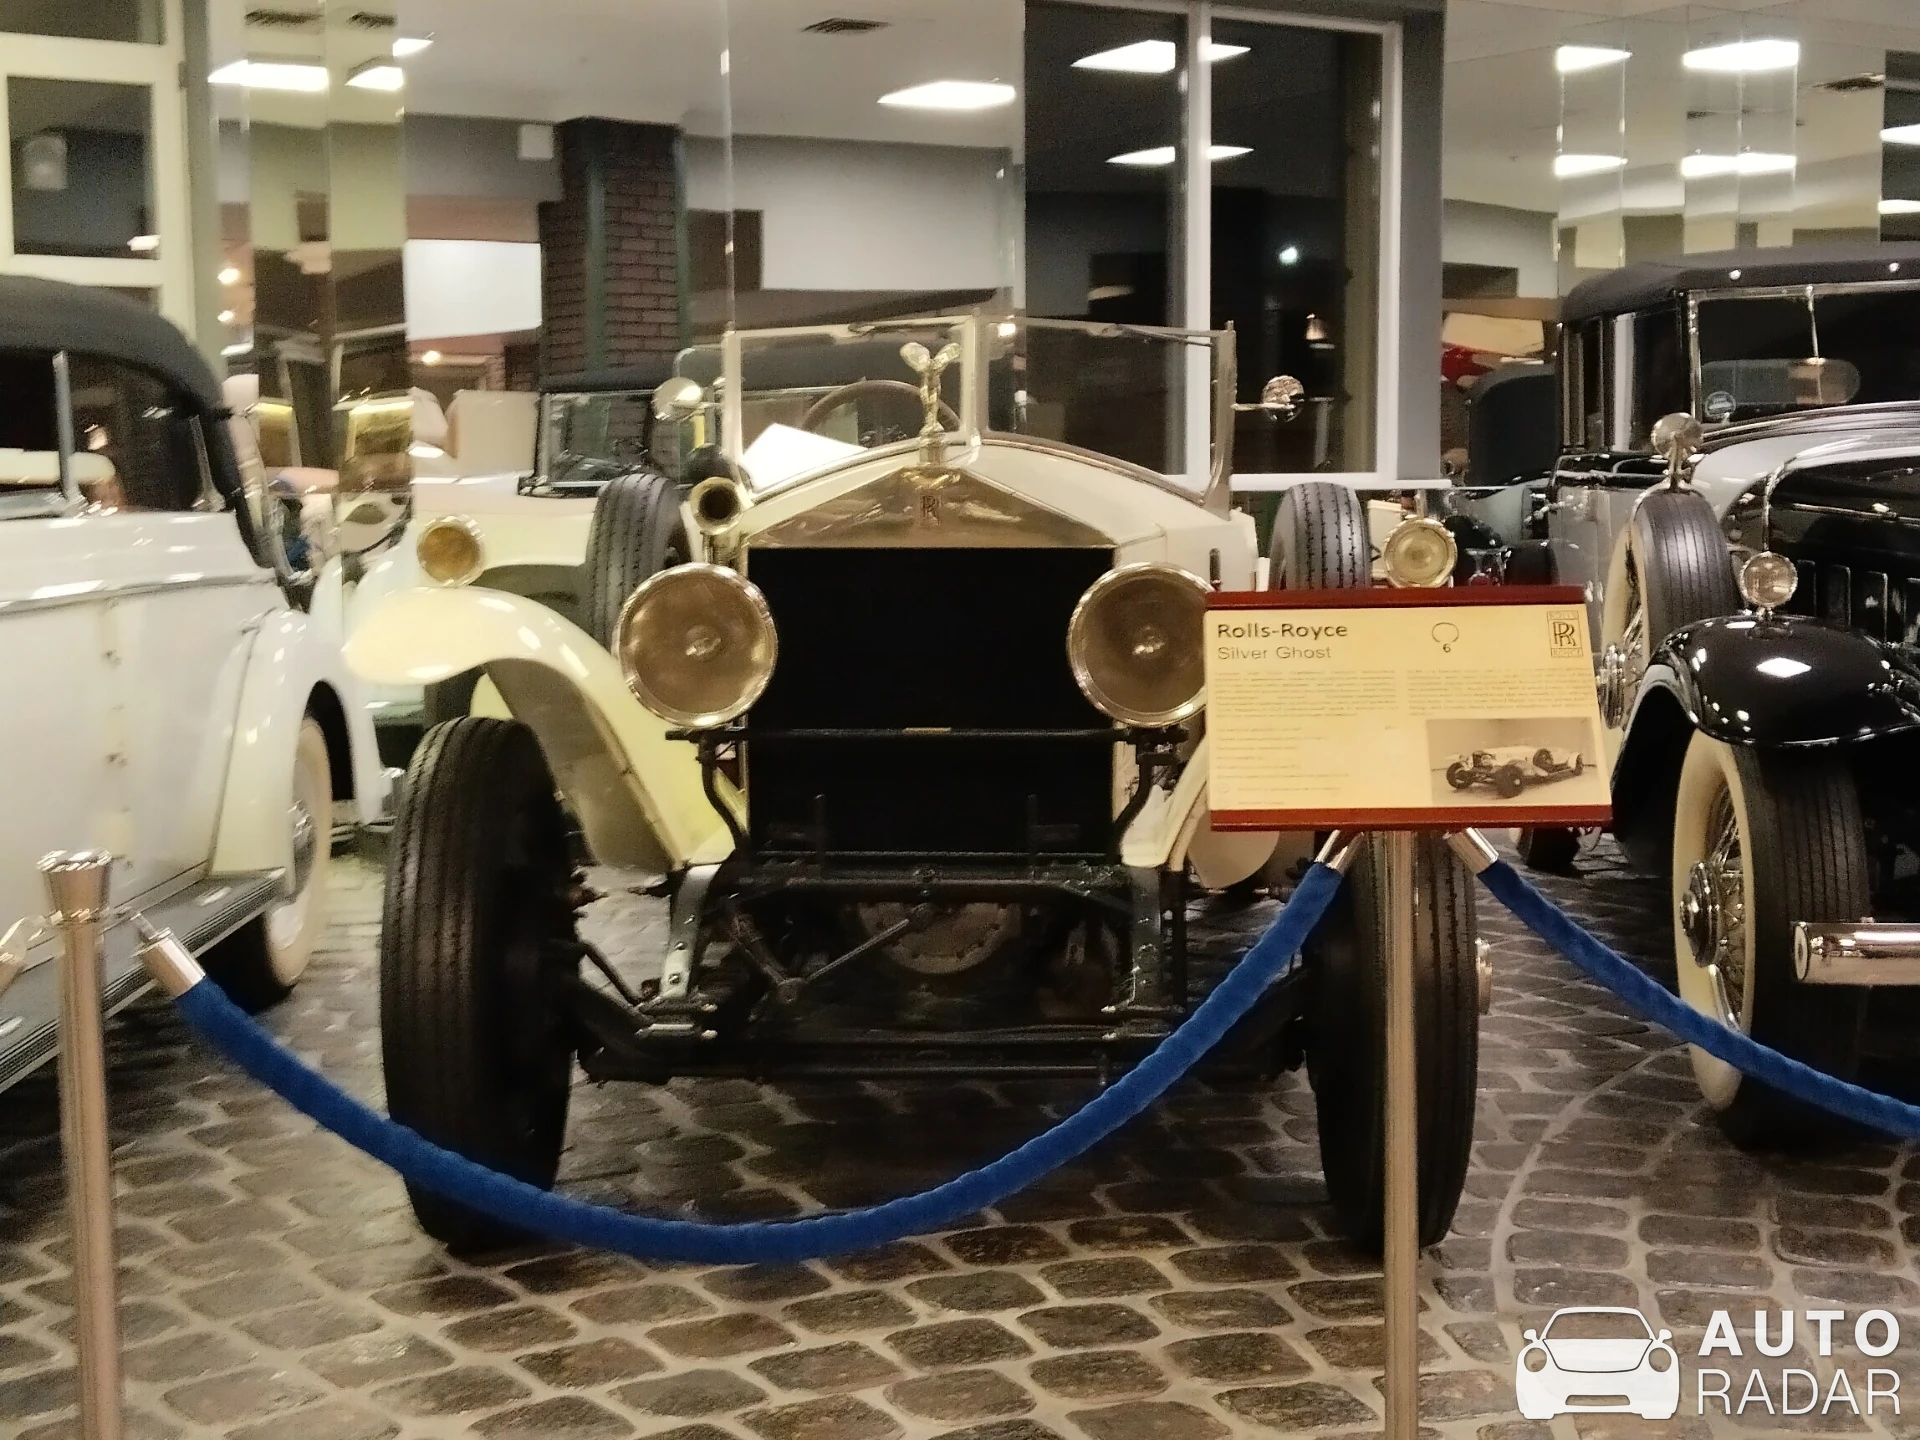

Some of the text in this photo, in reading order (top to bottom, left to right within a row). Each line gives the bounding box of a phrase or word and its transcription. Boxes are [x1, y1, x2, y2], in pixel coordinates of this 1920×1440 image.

[1217, 623, 1348, 640] Rolls-Royce
[1553, 622, 1576, 646] RR
[1217, 646, 1332, 660] Silver Ghost
[1442, 643, 1451, 653] 6
